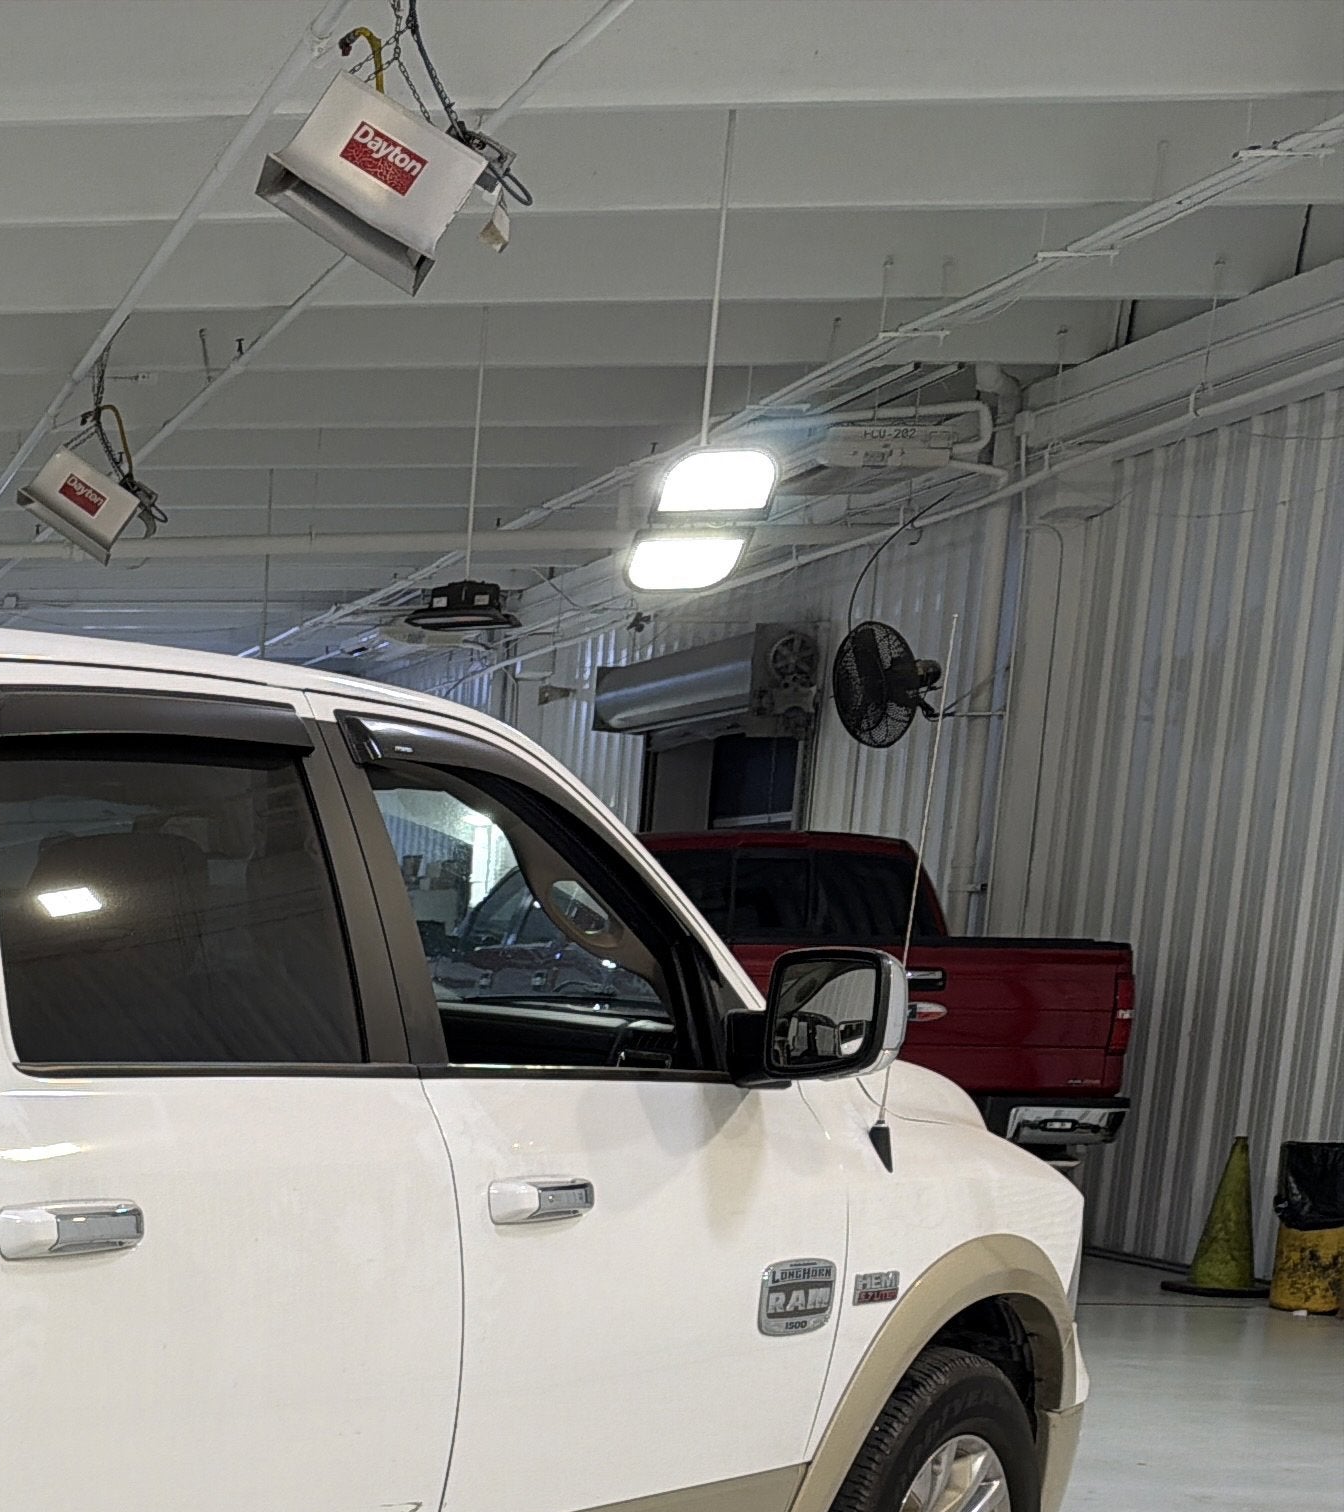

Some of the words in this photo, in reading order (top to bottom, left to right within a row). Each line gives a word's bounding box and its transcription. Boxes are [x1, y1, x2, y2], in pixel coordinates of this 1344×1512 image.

[353, 124, 422, 176] Dayton
[67, 476, 104, 506] Dayton
[767, 1287, 831, 1314] RAM
[784, 1320, 808, 1330] 1500
